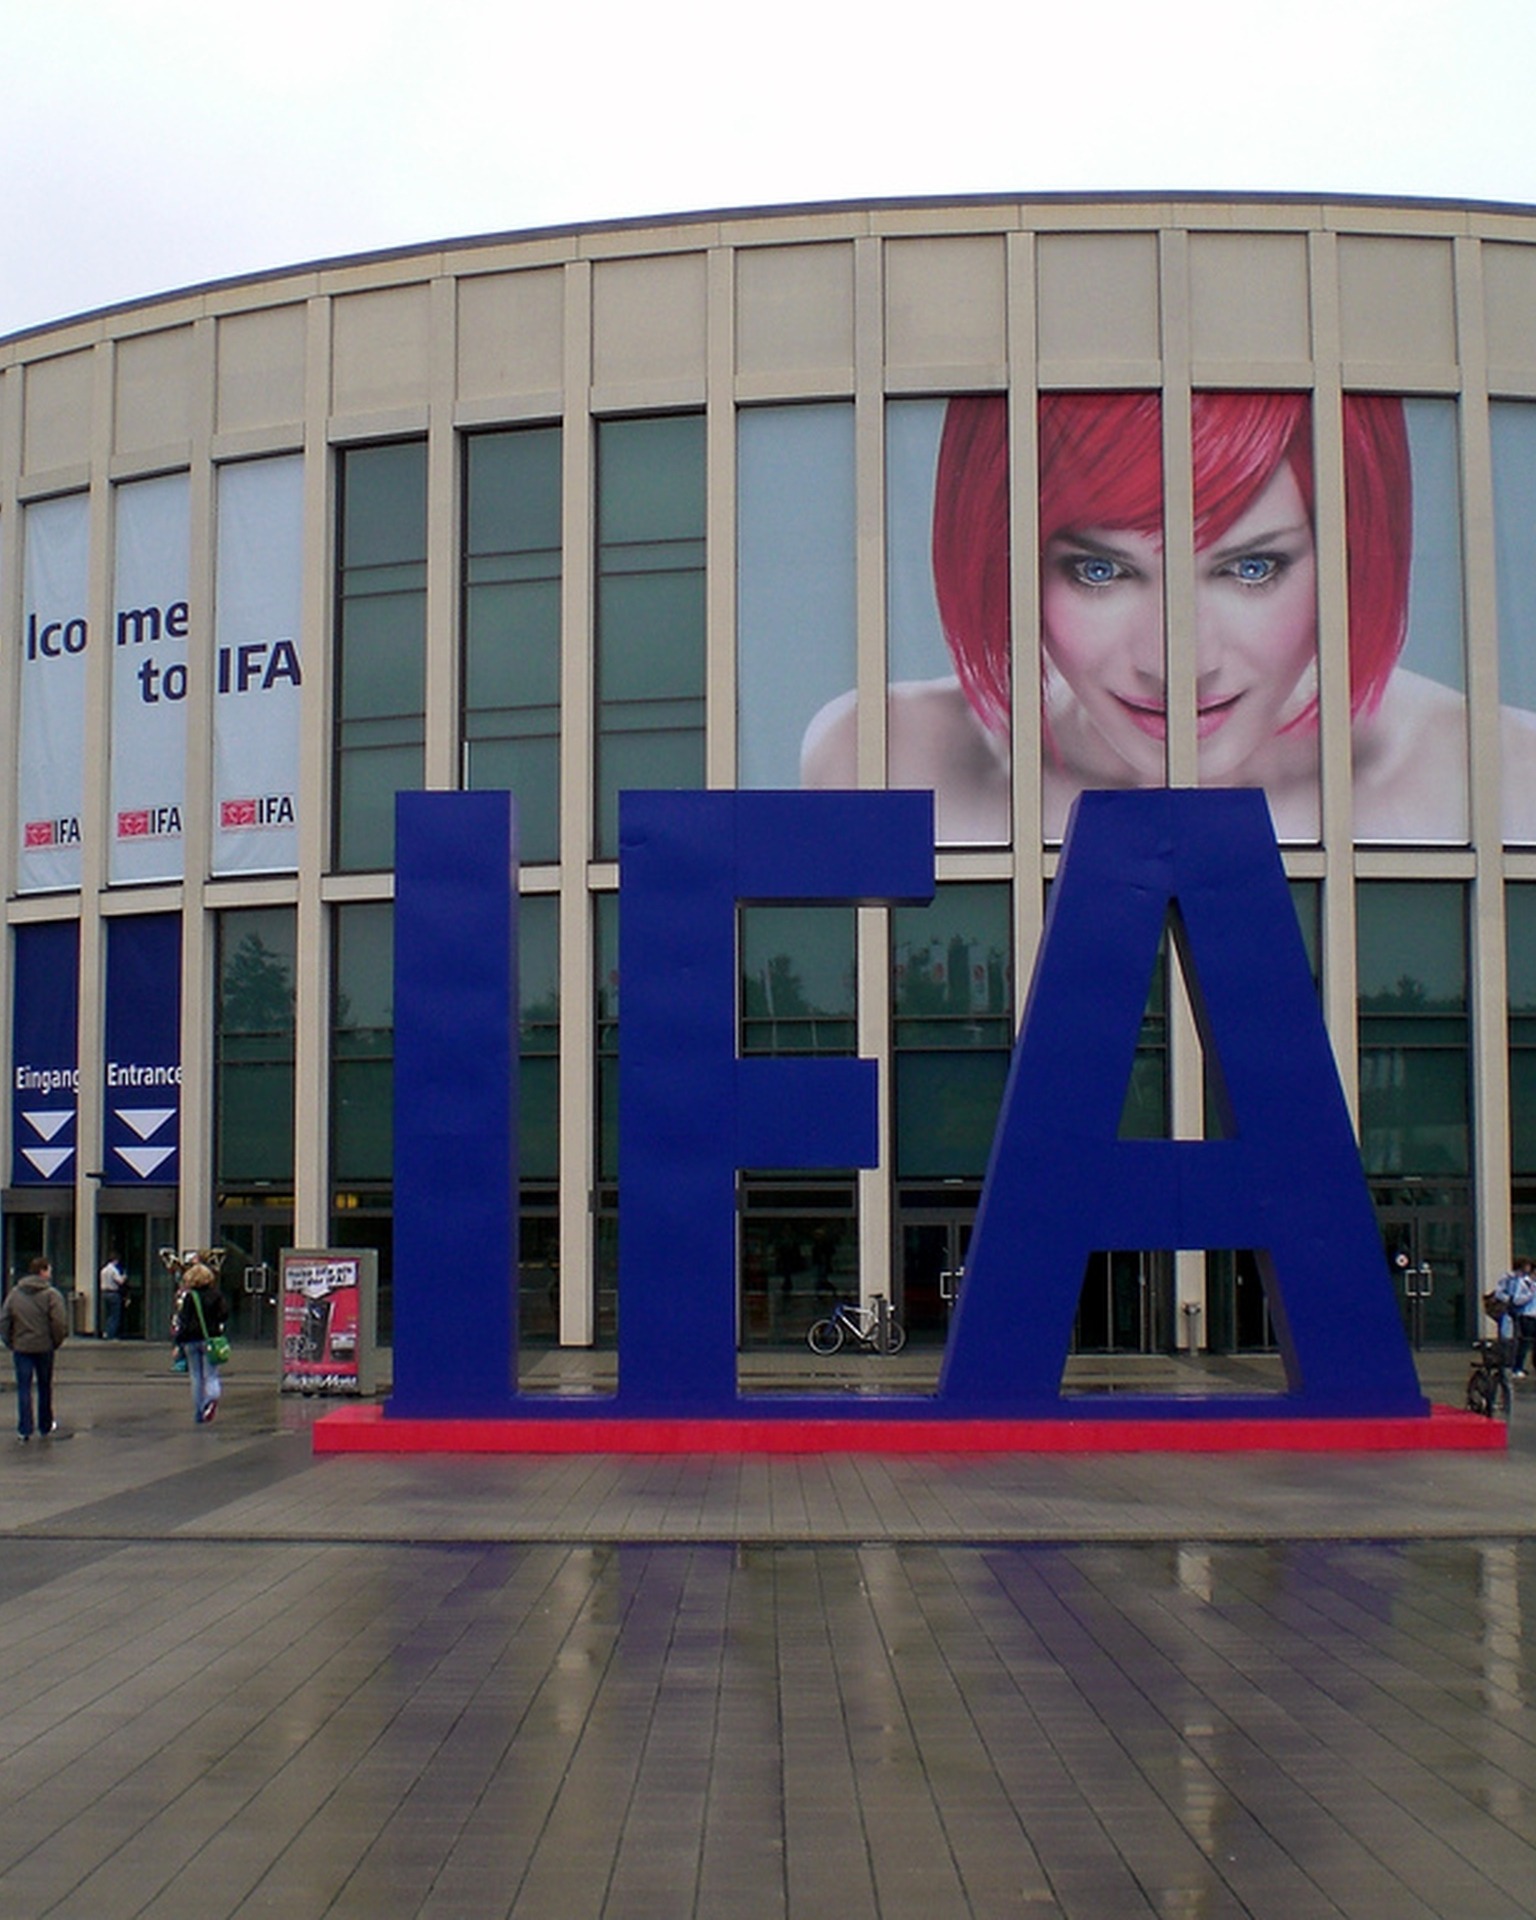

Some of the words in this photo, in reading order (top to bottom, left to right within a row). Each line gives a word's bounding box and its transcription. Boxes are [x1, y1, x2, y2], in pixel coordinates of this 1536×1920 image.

[138, 658, 188, 703] to
[218, 640, 302, 693] IFA
[151, 807, 182, 834] IFA
[259, 797, 294, 824] IFA
[54, 817, 81, 845] IFA
[107, 1063, 182, 1086] Entrance
[394, 789, 1421, 1399] IFA
